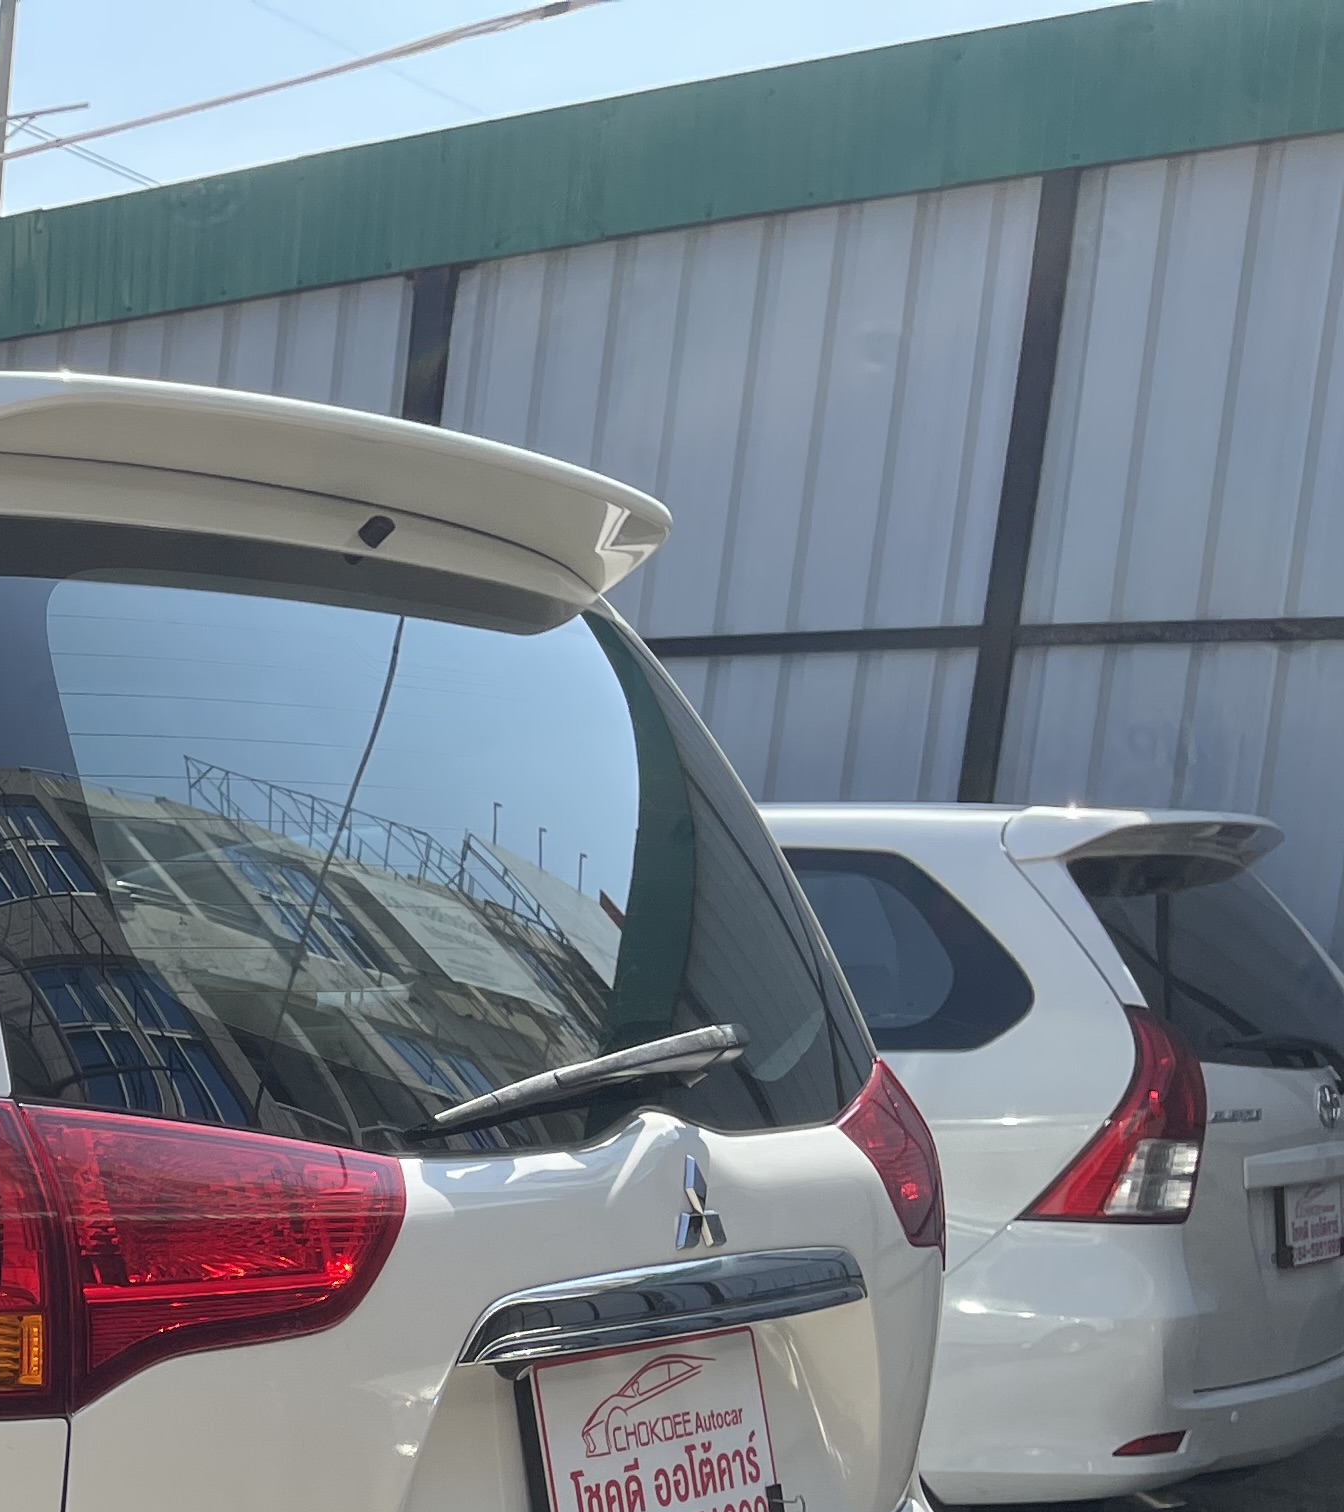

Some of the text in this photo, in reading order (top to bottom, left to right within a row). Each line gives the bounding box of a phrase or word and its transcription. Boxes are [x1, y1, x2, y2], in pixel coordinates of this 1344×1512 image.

[612, 1407, 743, 1452] CHOKDEE Autocar
[654, 1429, 761, 1507] ออโต้คาร์
